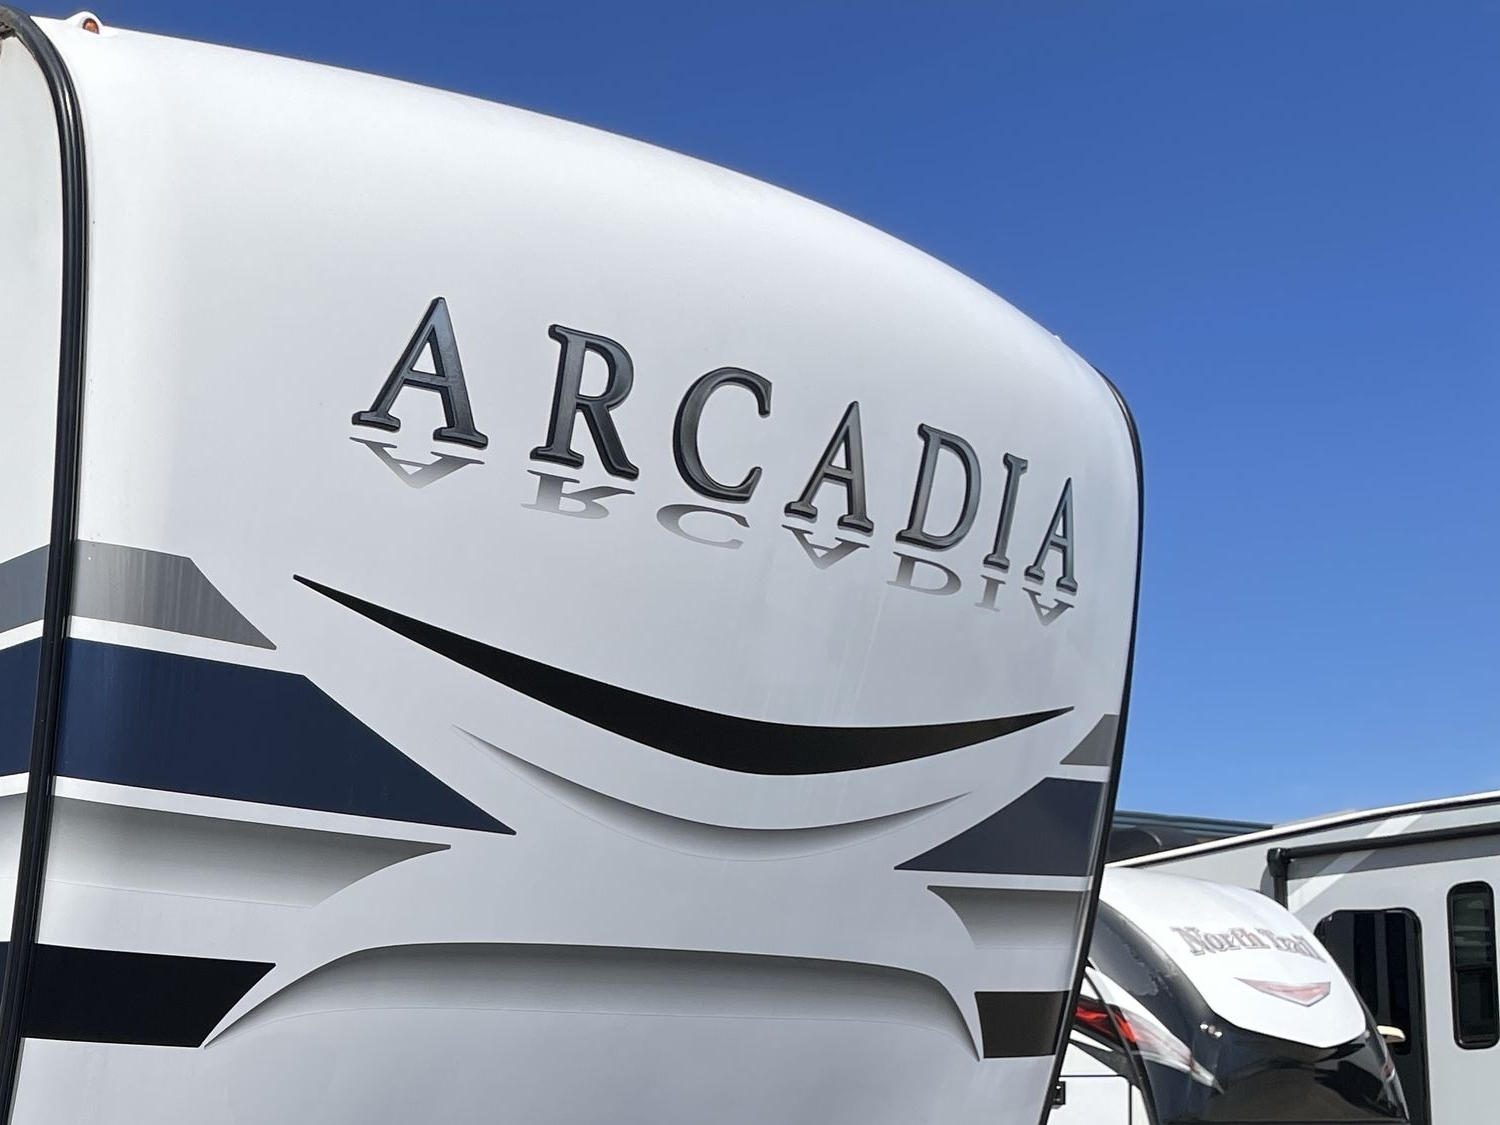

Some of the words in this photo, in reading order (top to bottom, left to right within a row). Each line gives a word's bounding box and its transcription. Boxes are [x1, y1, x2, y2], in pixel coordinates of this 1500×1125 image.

[351, 296, 1078, 596] ARCADIA
[1169, 926, 1270, 956] North
[1254, 927, 1327, 963] Trail
